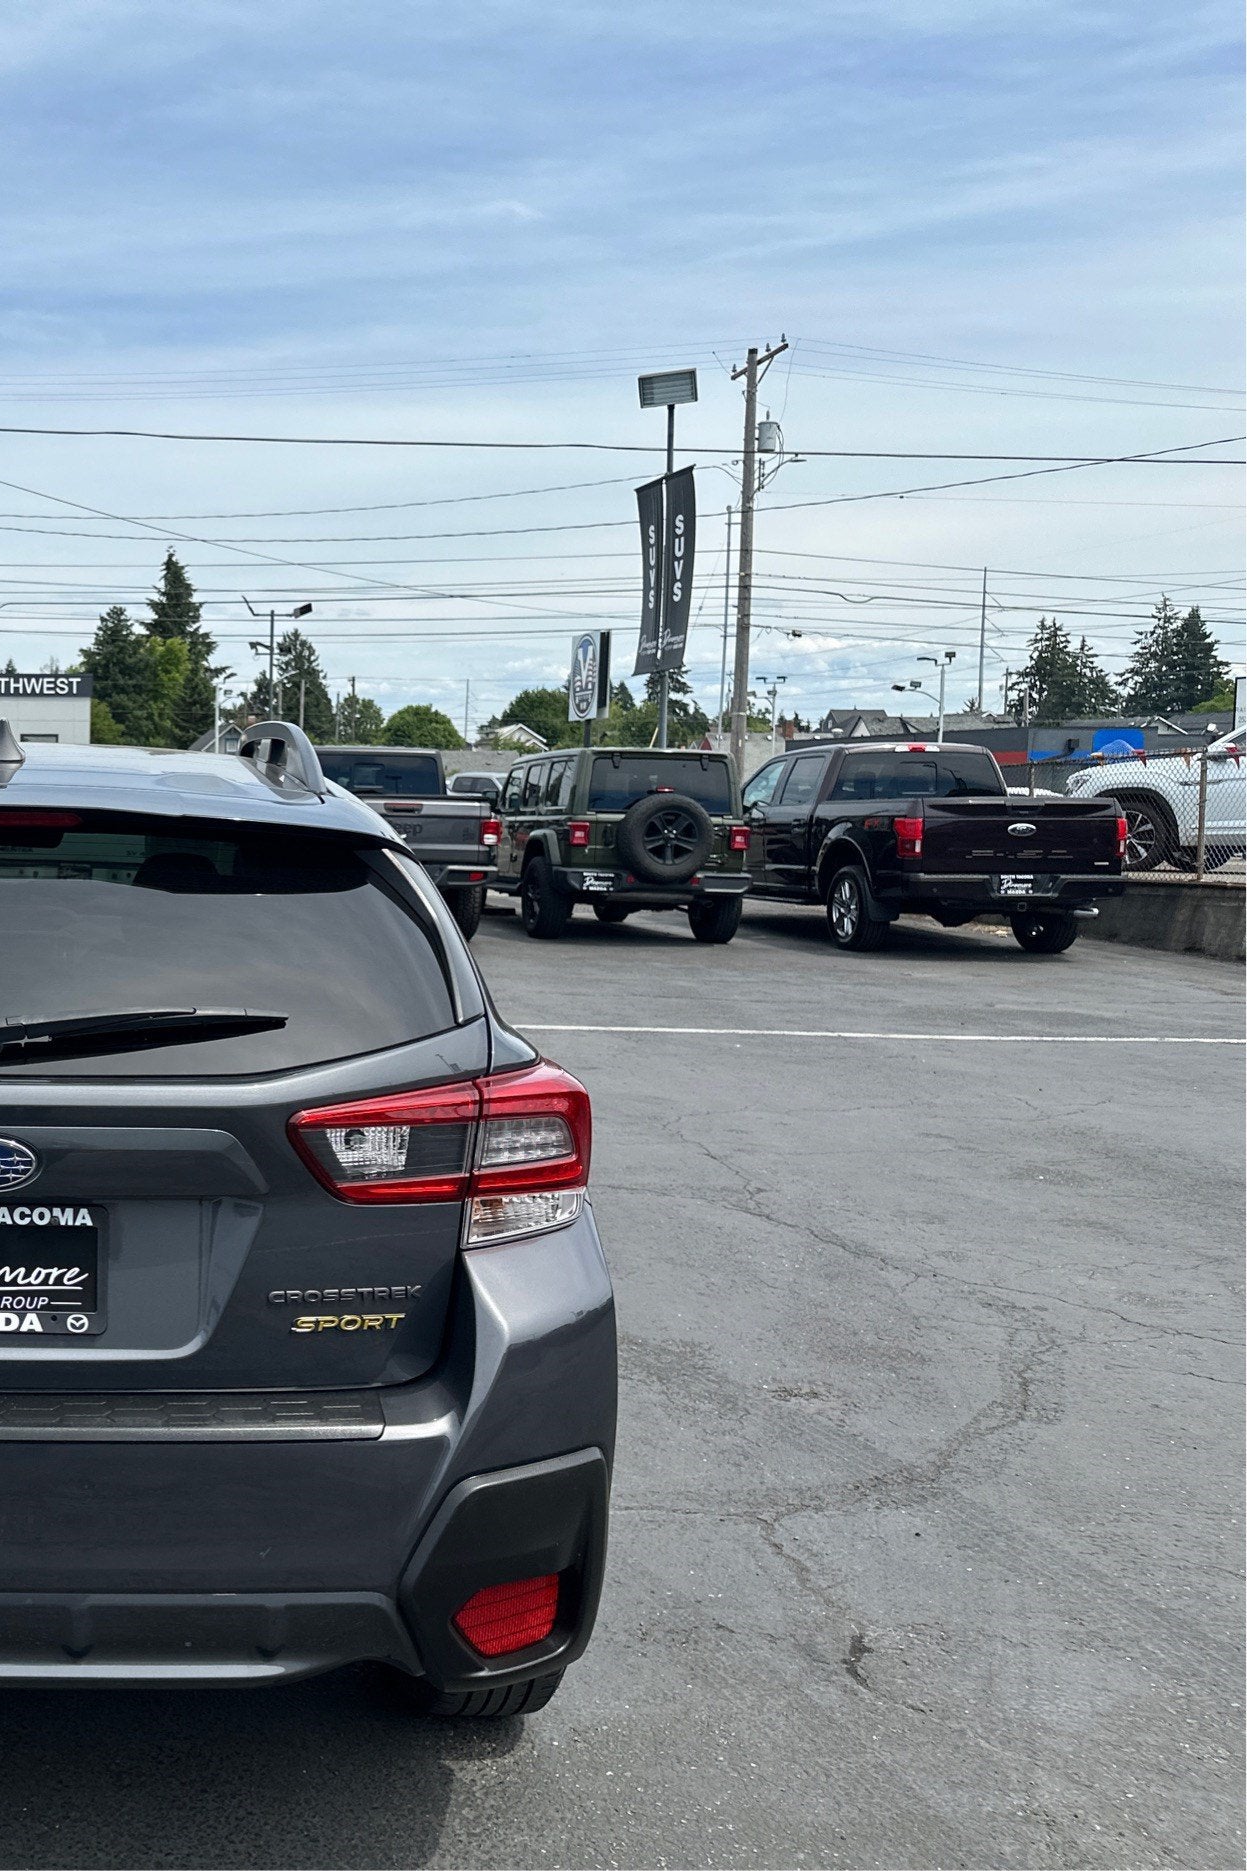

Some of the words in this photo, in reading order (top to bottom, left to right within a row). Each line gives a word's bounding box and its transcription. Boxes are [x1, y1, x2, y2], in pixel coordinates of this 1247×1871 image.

[648, 525, 656, 609] SUVS
[672, 514, 685, 602] SUVS
[267, 1285, 422, 1303] CROSSTREK
[291, 1313, 407, 1333] SPORT
